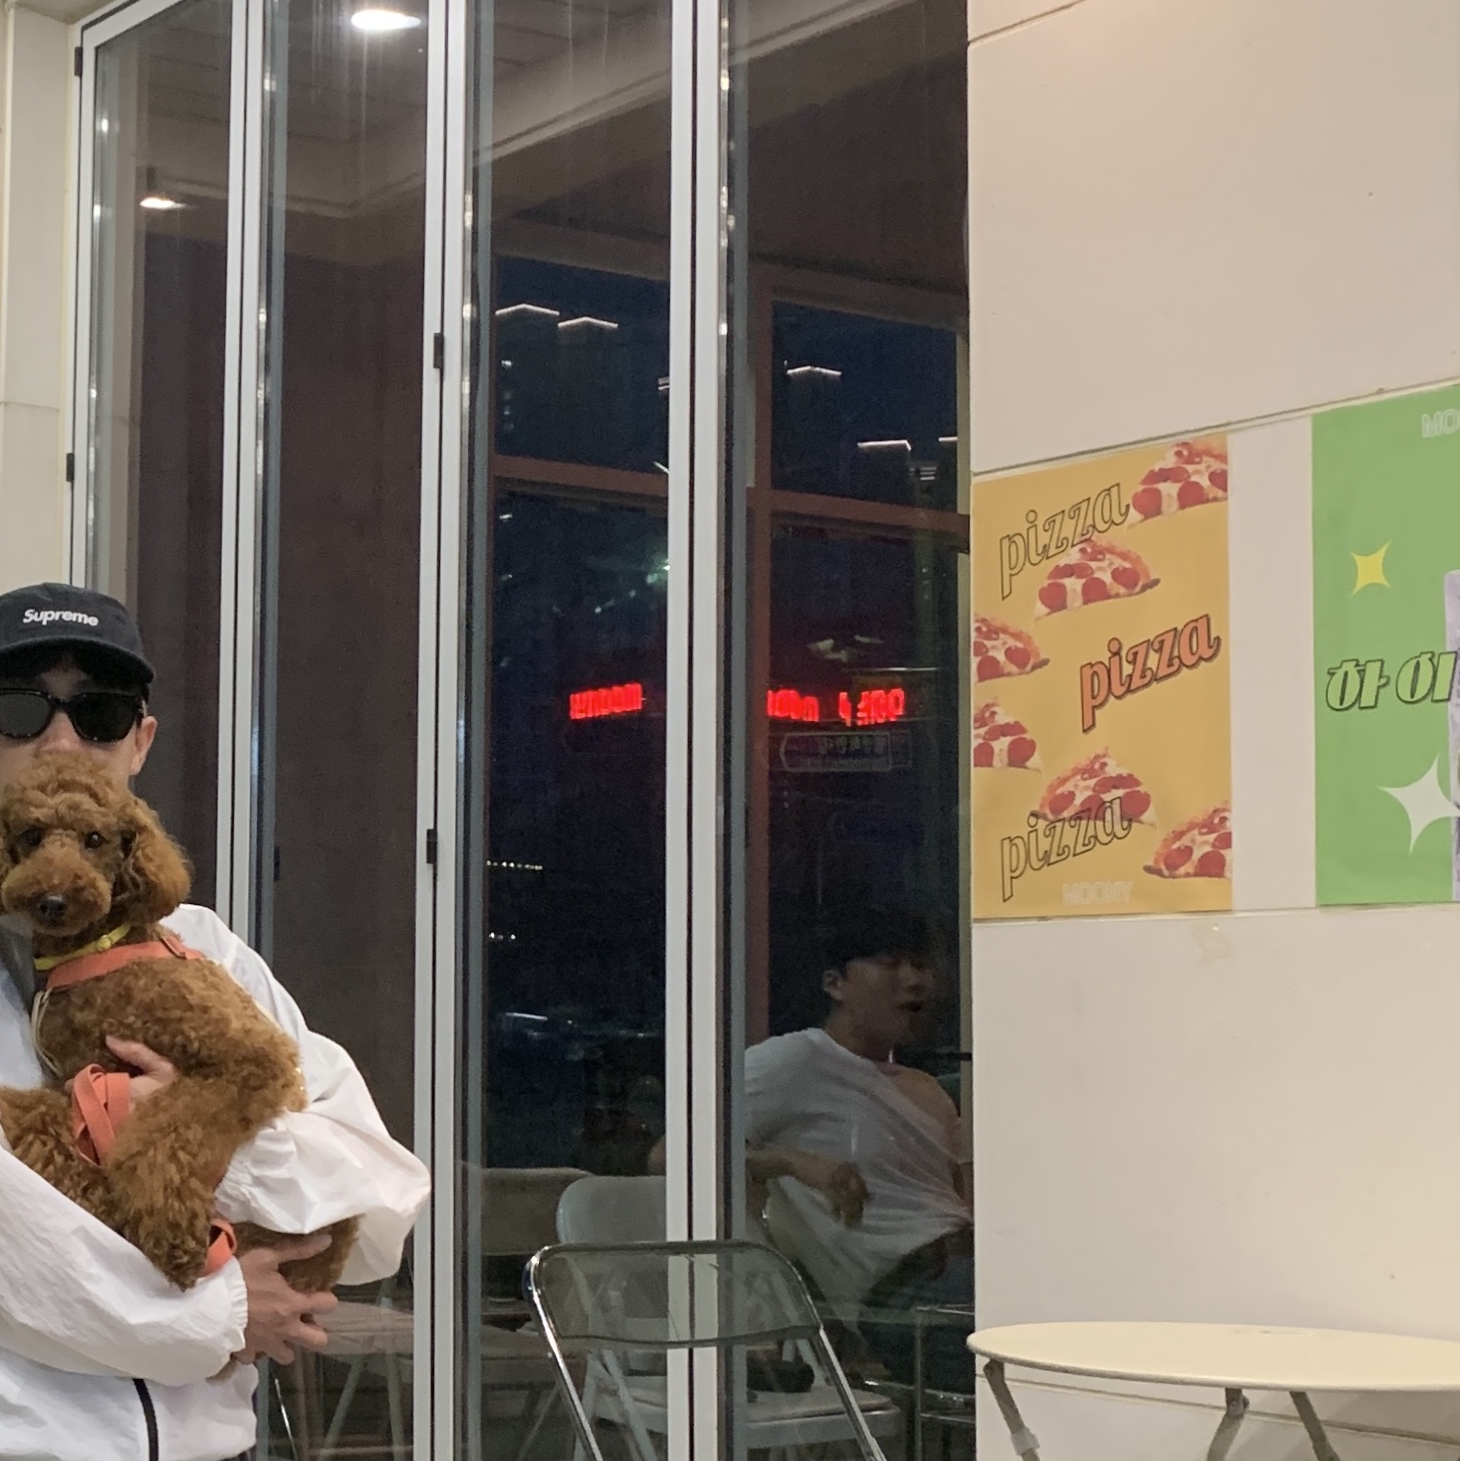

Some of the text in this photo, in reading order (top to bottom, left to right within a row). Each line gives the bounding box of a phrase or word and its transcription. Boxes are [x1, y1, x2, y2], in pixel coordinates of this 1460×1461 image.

[1420, 408, 1460, 438] MO
[999, 482, 1130, 601] pizza
[22, 608, 99, 626] Supreme
[1080, 613, 1222, 735] pizza
[1000, 796, 1133, 903] pizza
